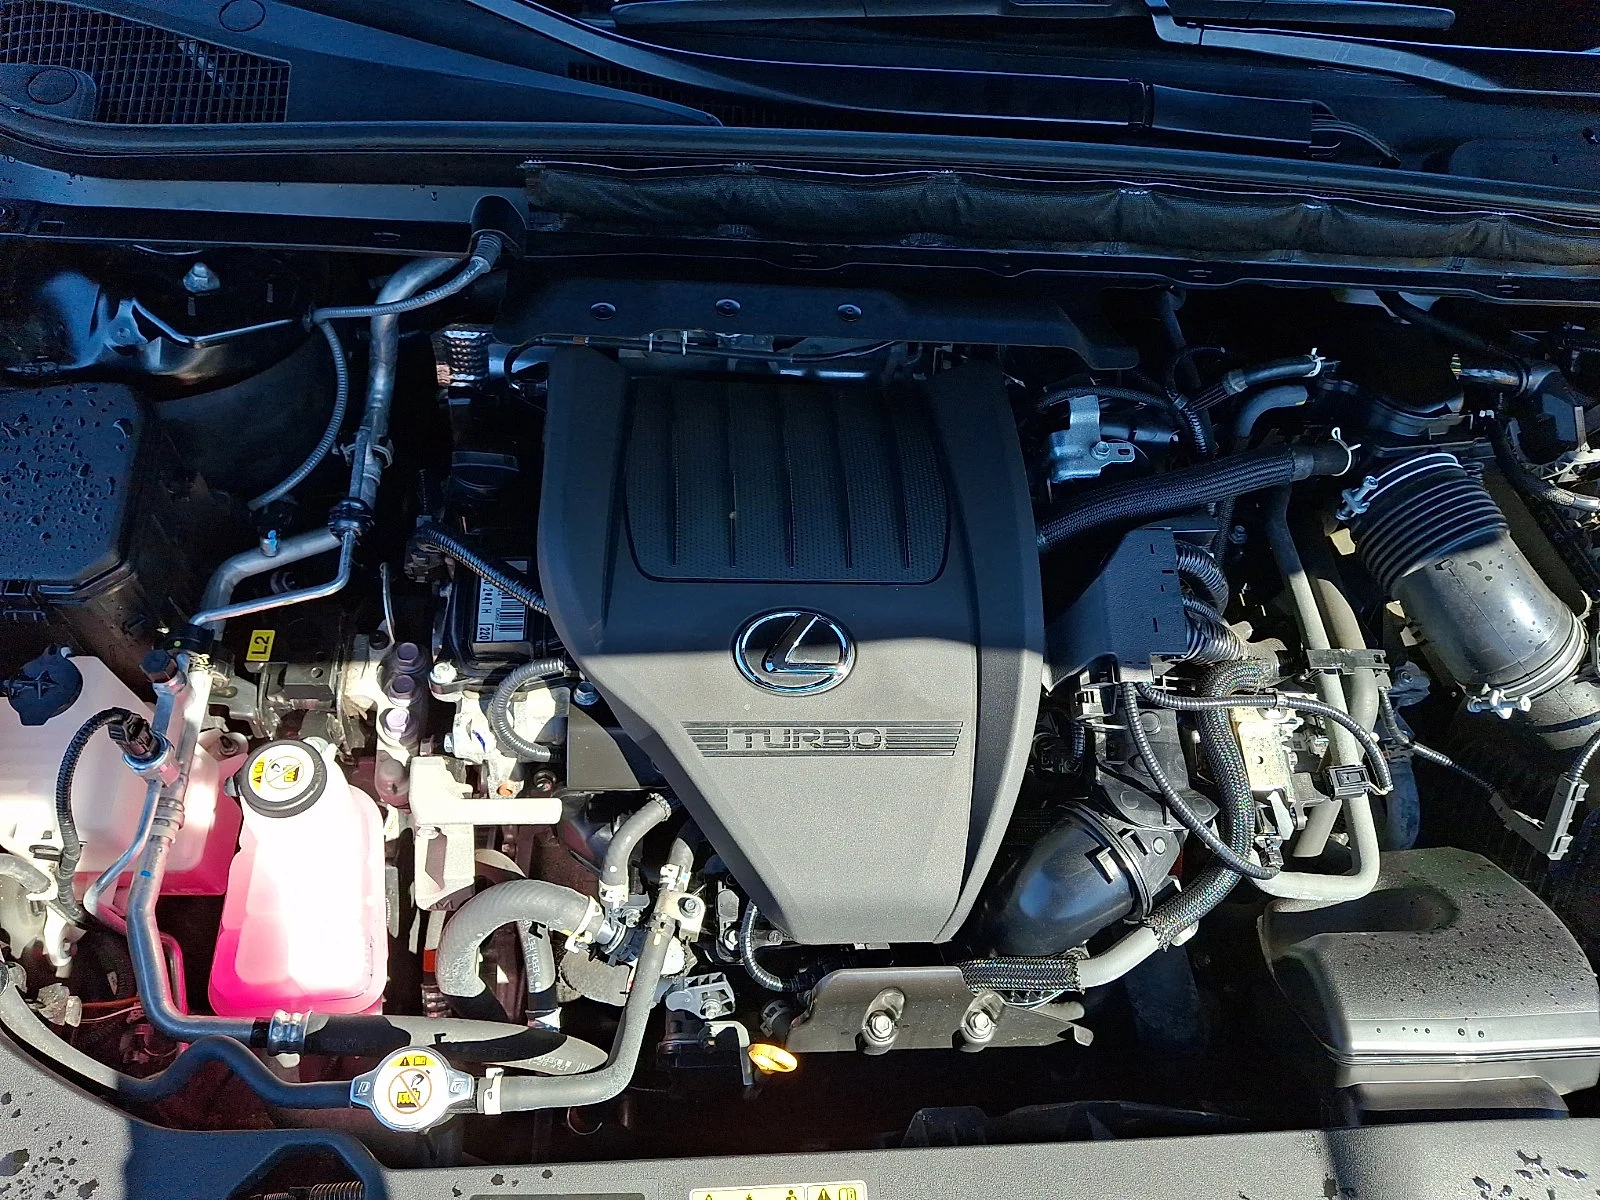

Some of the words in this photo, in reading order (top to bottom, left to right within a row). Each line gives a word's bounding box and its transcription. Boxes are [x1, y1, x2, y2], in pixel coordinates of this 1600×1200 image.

[479, 627, 490, 640] 220
[251, 635, 270, 655] L2
[731, 728, 882, 749] TURBO
